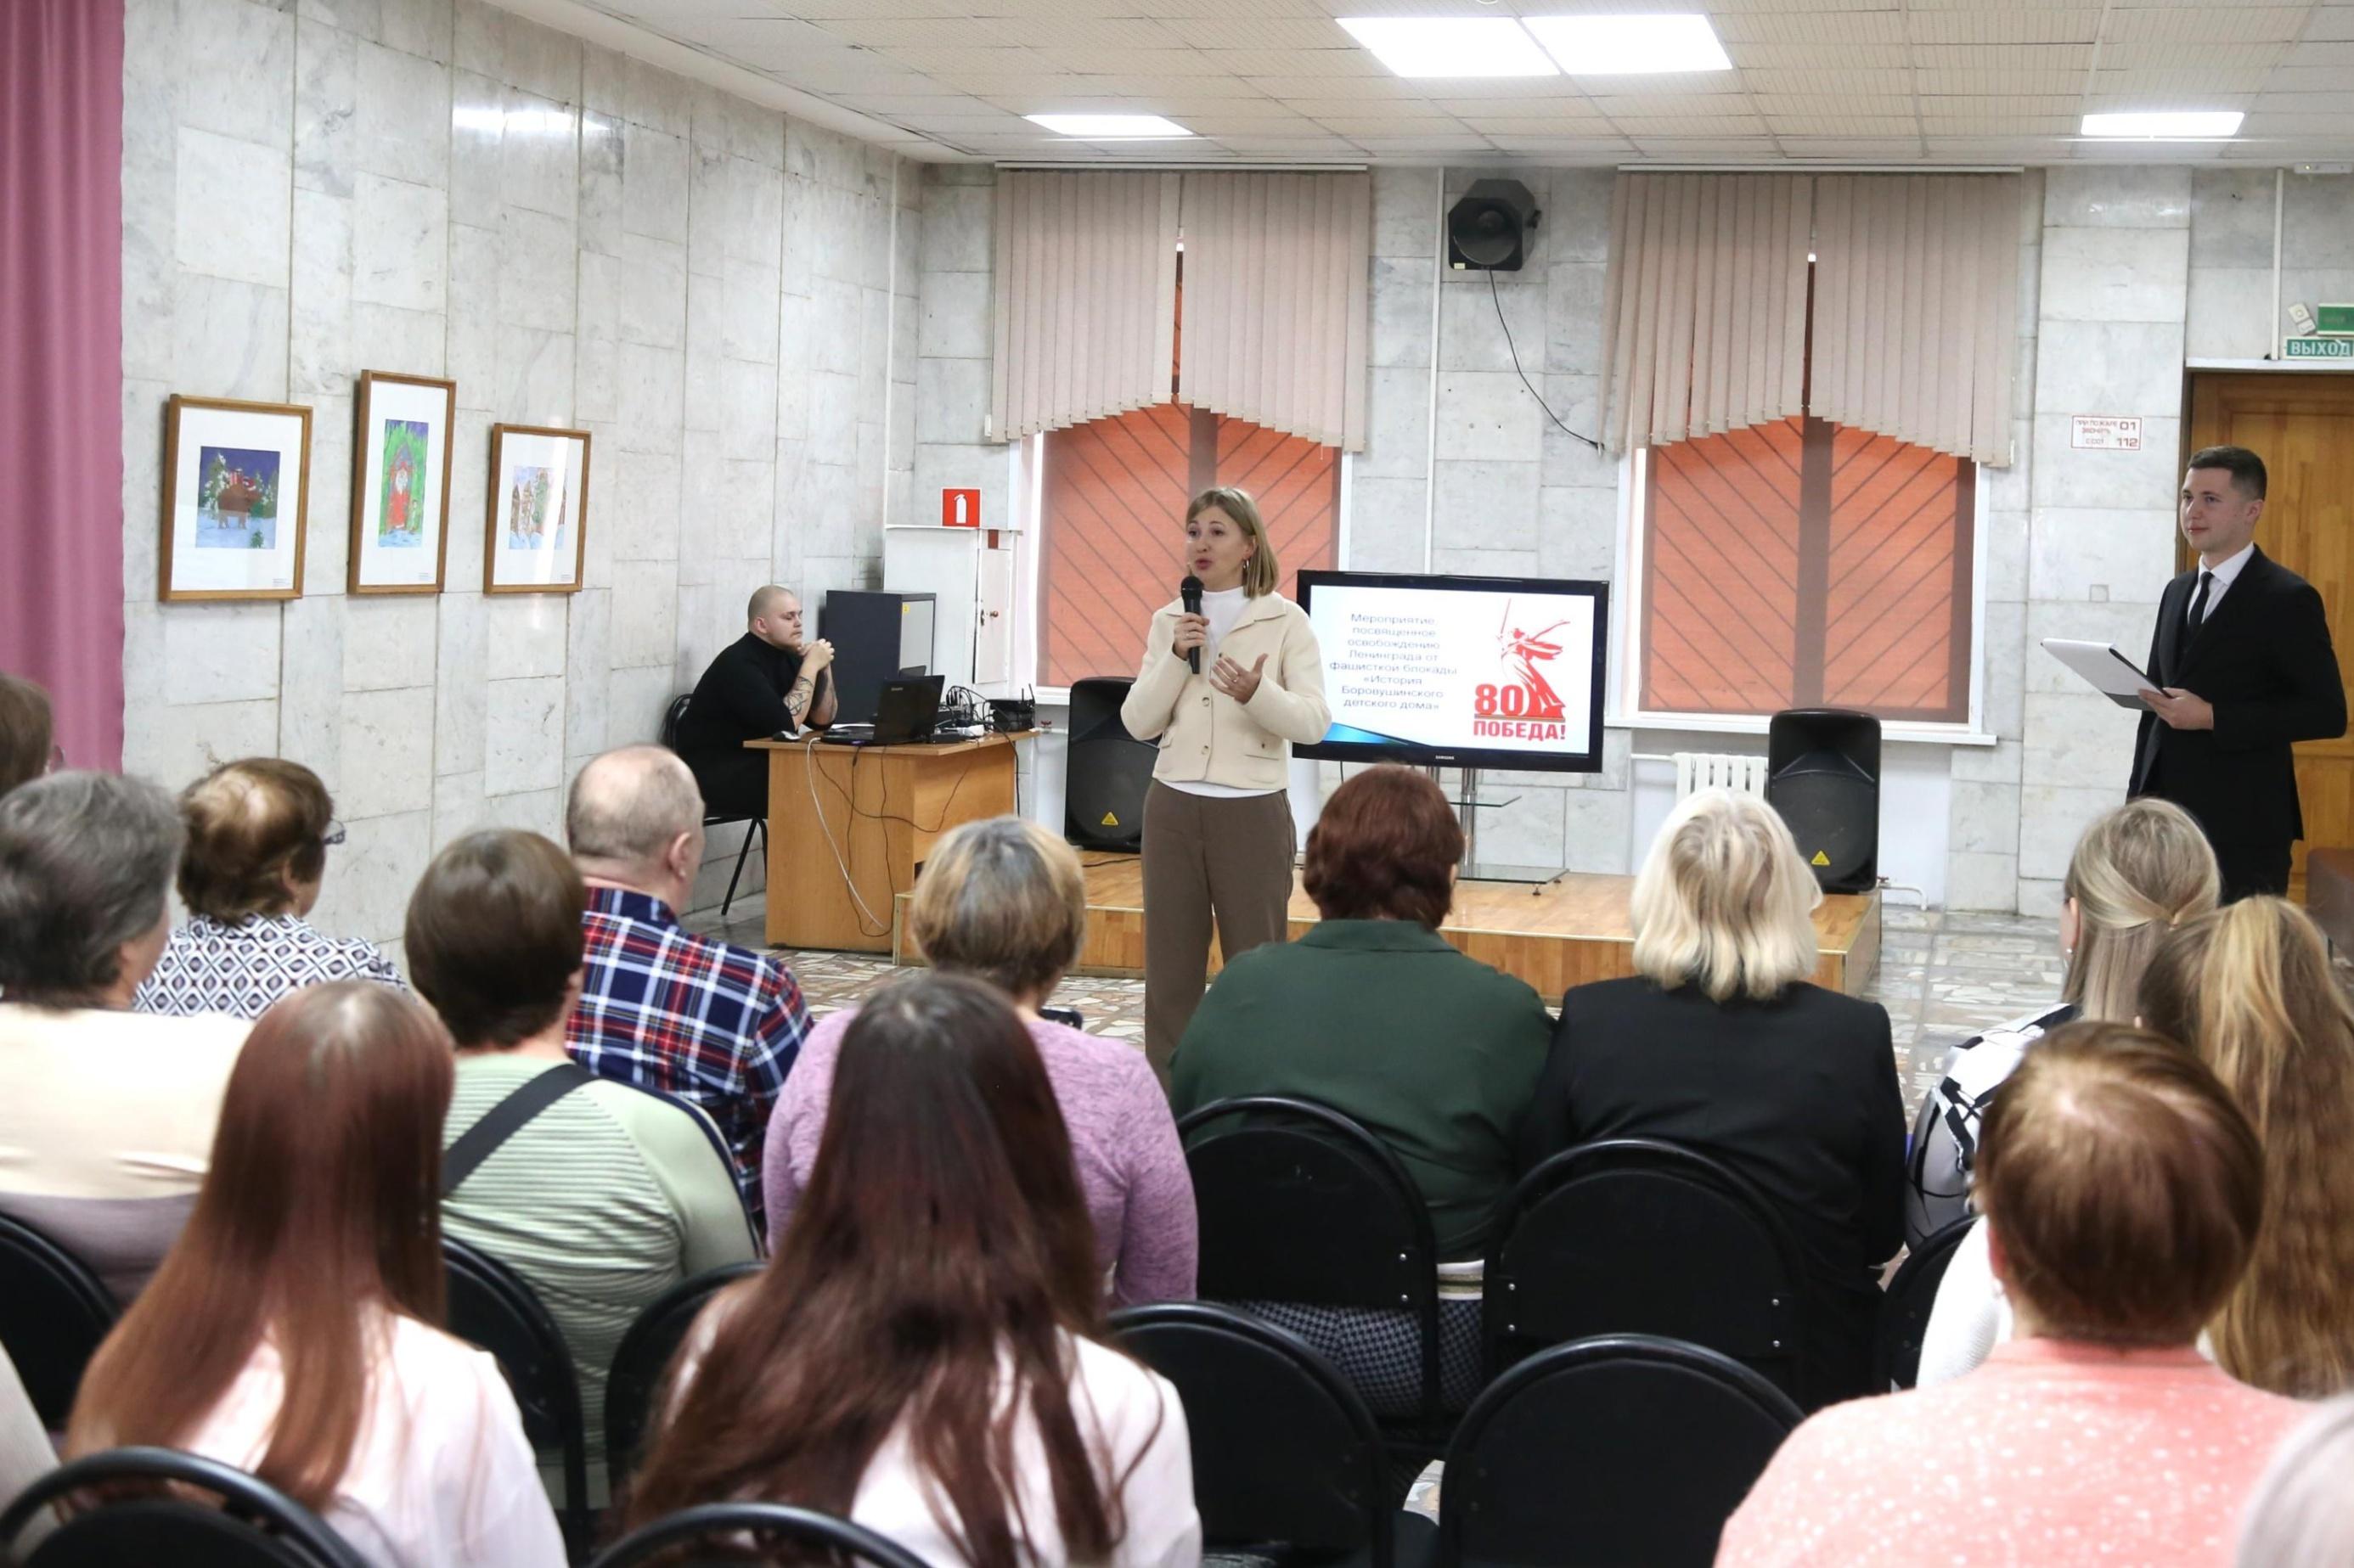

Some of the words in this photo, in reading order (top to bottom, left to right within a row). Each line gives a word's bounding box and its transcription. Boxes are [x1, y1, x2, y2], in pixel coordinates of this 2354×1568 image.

[2290, 340, 2351, 357] ВЫХОД
[2120, 421, 2137, 430] 01
[2117, 437, 2138, 447] 112
[1347, 638, 1440, 649] освобождению
[1349, 649, 1422, 661] Ленинграда
[1403, 664, 1457, 676] блокады
[1343, 699, 1397, 708] детского
[1474, 683, 1523, 717] 80
[1473, 720, 1566, 741] ПОБЕДА!
